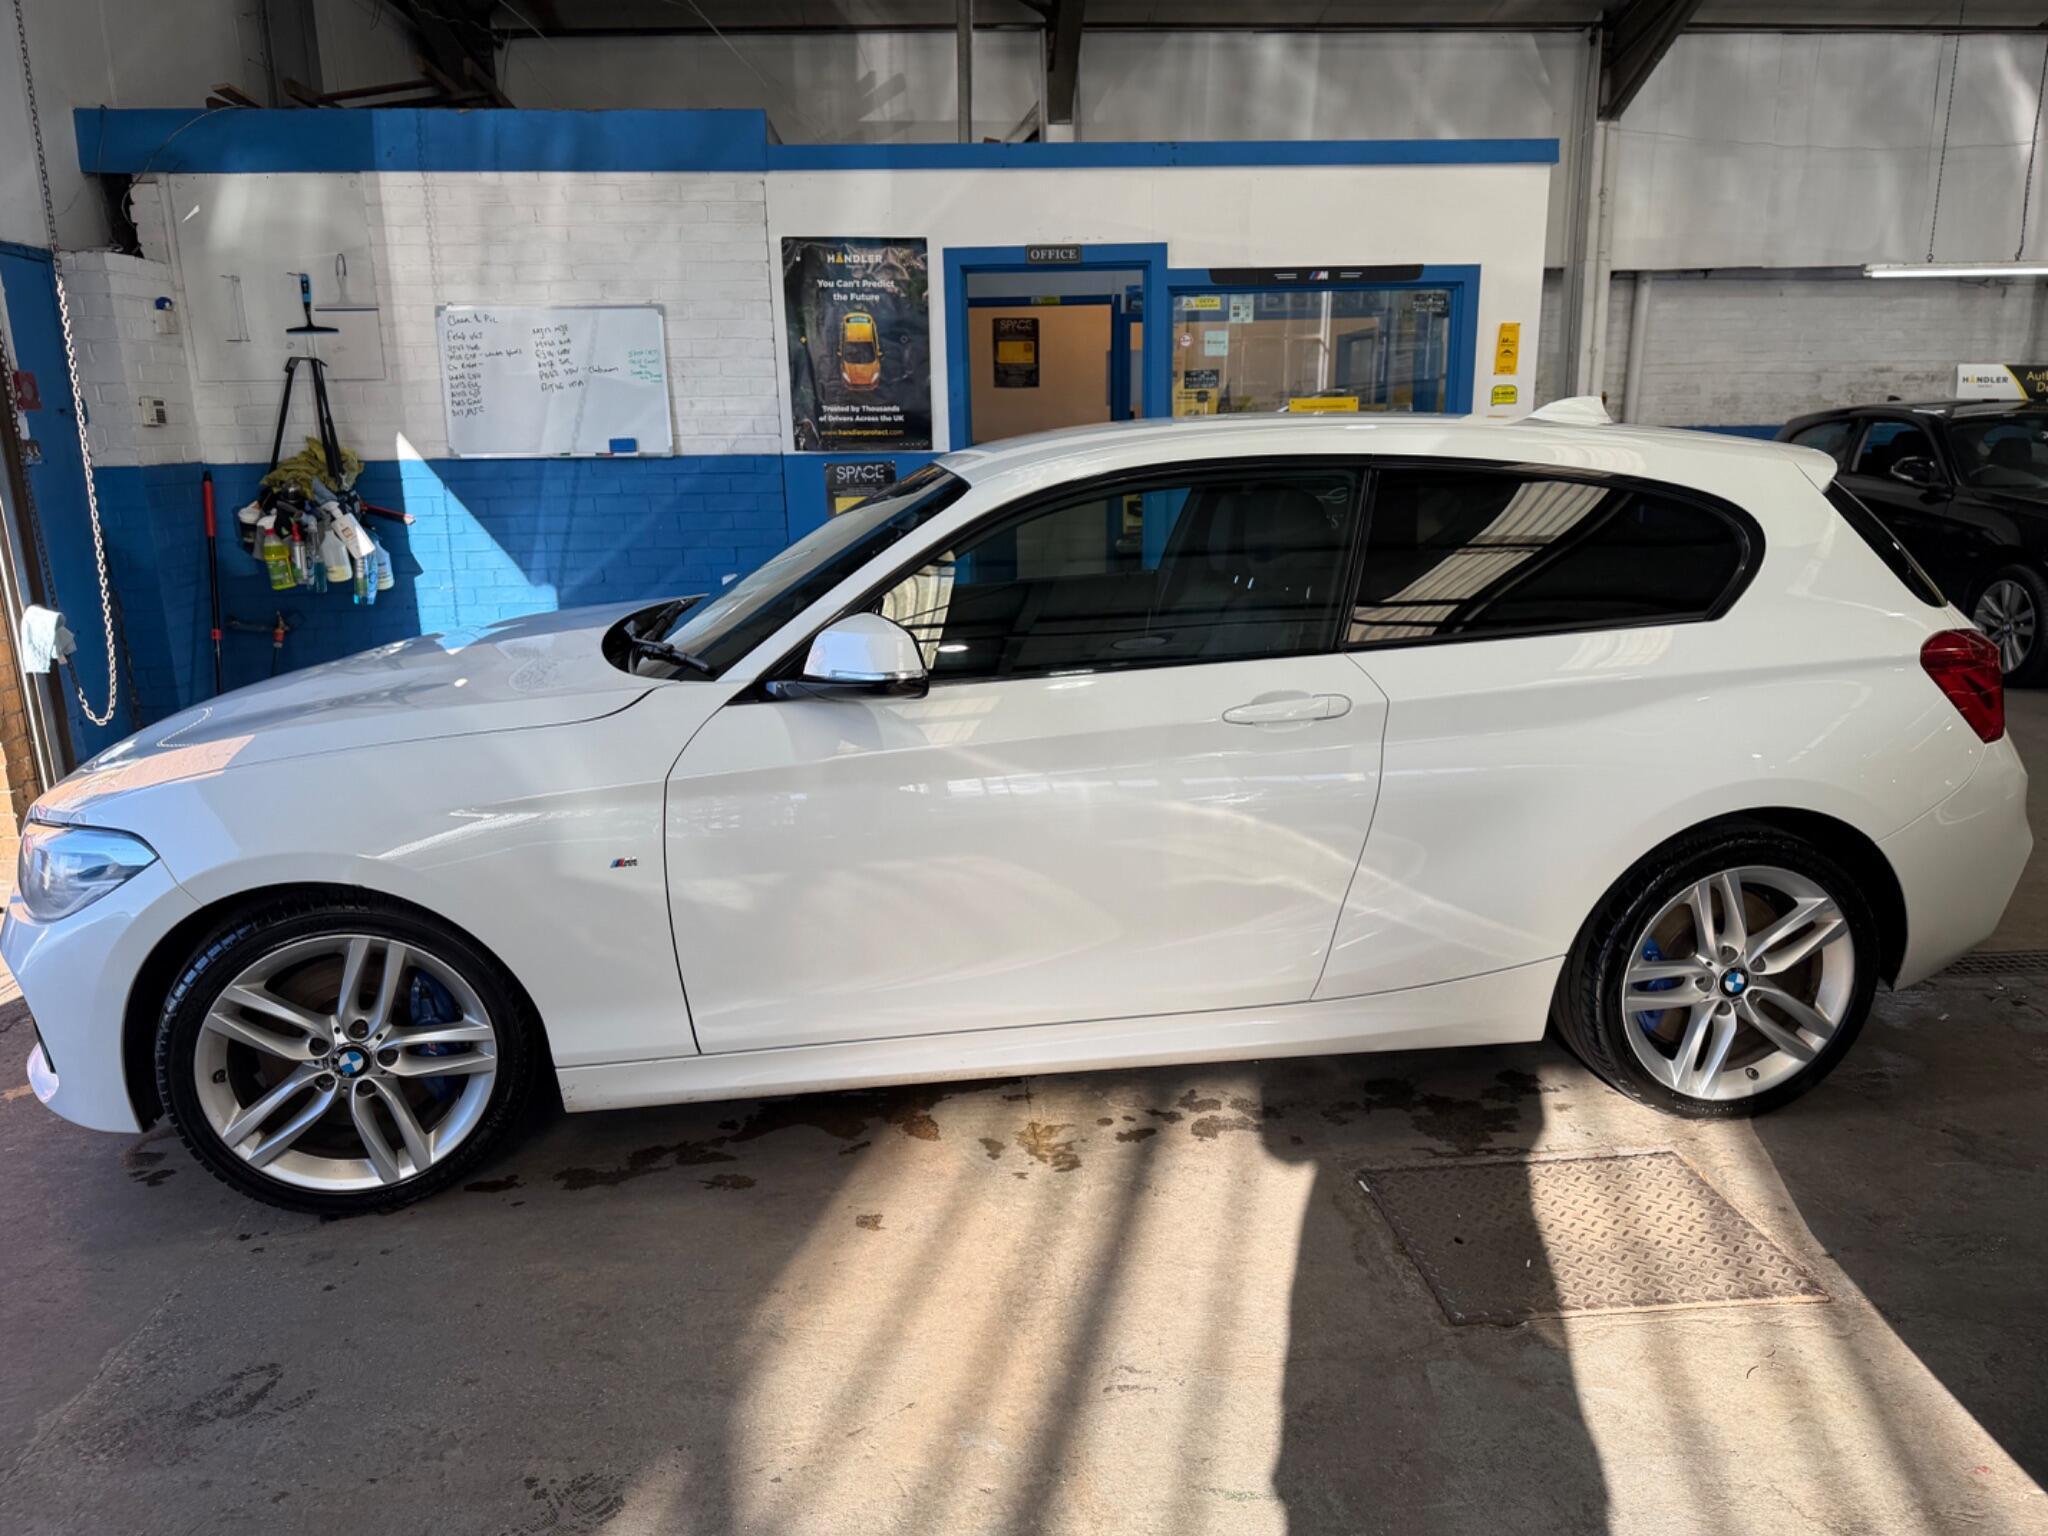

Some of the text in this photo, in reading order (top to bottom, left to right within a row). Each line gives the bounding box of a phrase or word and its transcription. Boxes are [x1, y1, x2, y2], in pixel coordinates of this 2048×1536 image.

[826, 253, 883, 264] HANDLER
[1030, 248, 1077, 260] OFFICE
[816, 279, 895, 288] You Can't Predict
[833, 293, 880, 302] the Future
[1000, 319, 1032, 329] SPACE
[1962, 375, 2009, 384] HANDLER
[851, 405, 860, 413] by
[836, 464, 884, 480] SPACE
